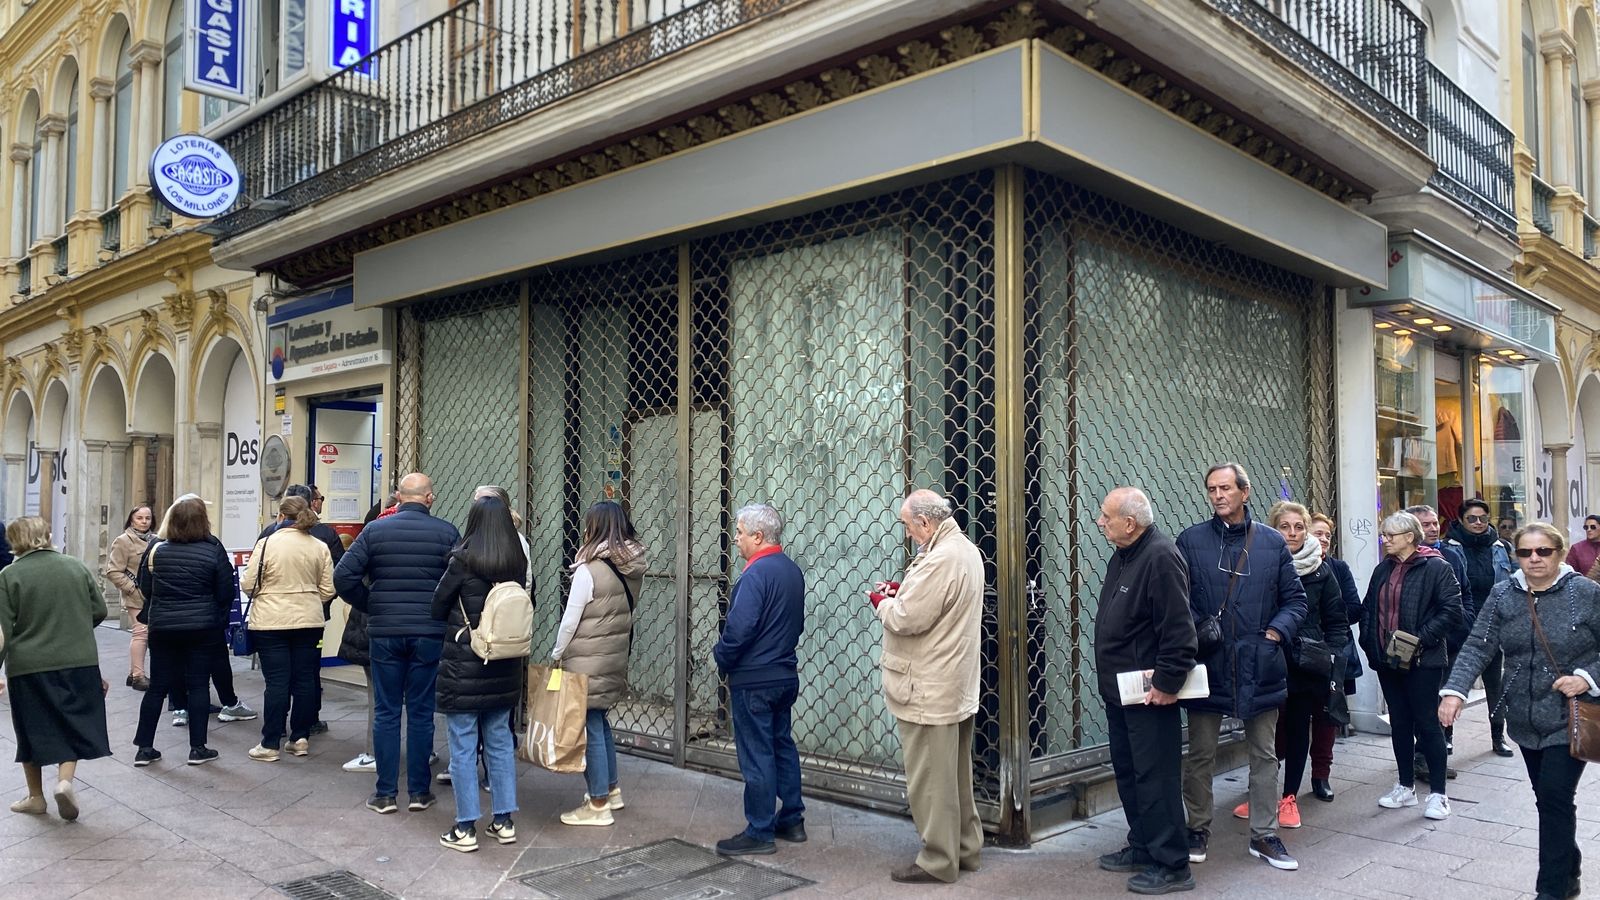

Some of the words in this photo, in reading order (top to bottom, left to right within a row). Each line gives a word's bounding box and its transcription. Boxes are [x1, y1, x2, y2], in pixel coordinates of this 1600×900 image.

[169, 140, 222, 160] LOTERÍAS
[169, 163, 223, 187] SAGASTA
[166, 185, 184, 203] LOS
[183, 192, 229, 211] MILLONES
[345, 327, 379, 349] Estado
